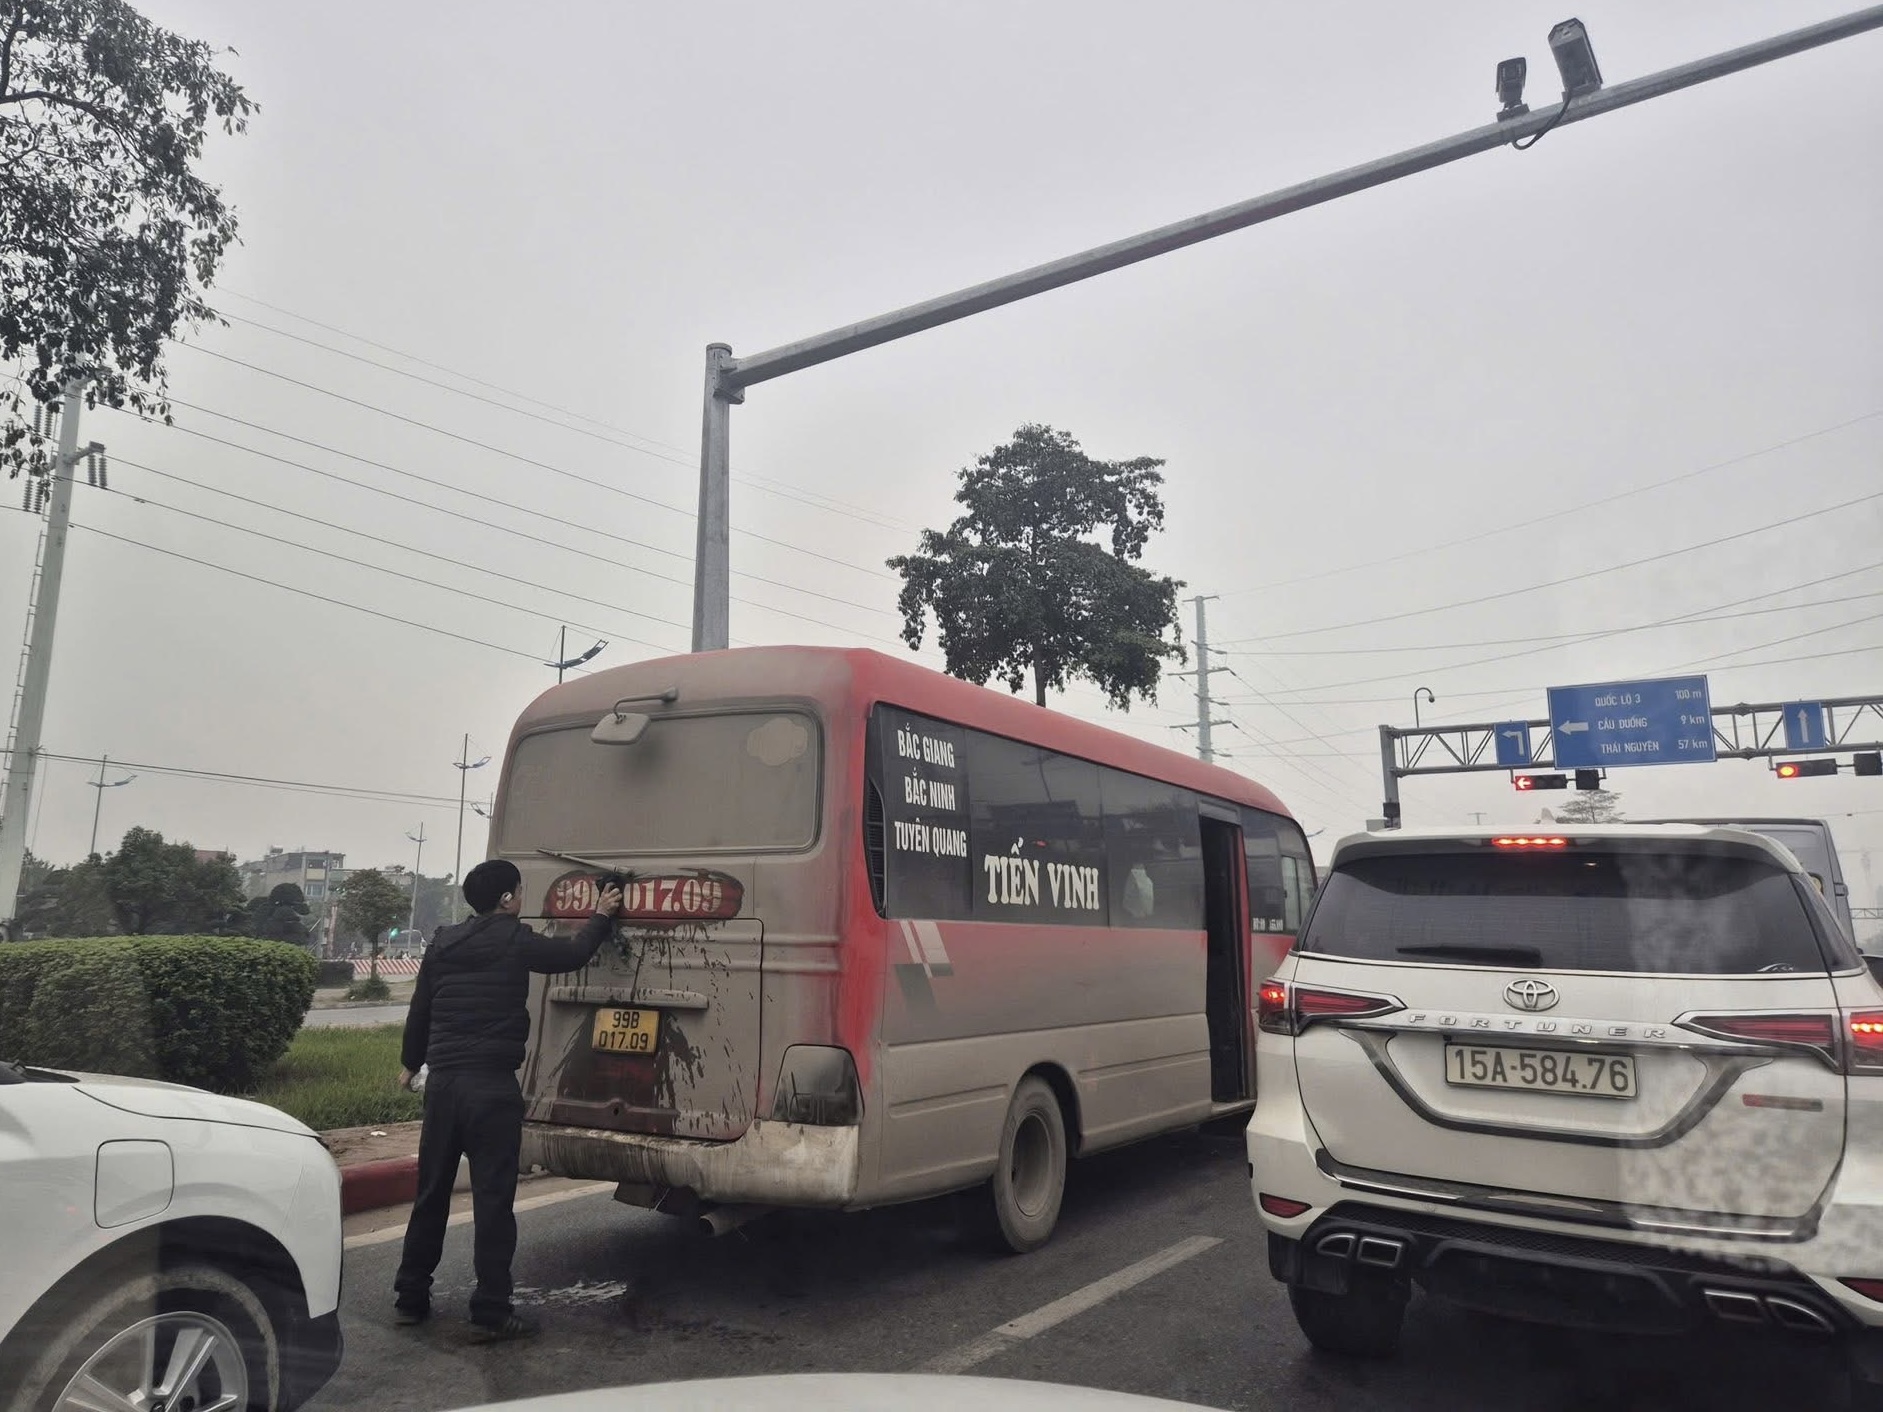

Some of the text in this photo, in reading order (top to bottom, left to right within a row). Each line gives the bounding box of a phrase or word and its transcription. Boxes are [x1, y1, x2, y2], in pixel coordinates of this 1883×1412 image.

[1635, 693, 1641, 704] 3
[1675, 689, 1690, 700] 100
[1692, 690, 1702, 699] m
[1680, 715, 1687, 725] 9
[1689, 715, 1705, 725] km
[897, 722, 955, 768] BẮC GIANG
[1601, 742, 1621, 754] THÁI
[1678, 739, 1689, 750] 57
[1692, 739, 1708, 749] km
[904, 766, 955, 811] BẮC NINH
[894, 817, 967, 858] TUYÊN QUANG
[984, 836, 1099, 911] TIẾN VINH
[612, 1011, 640, 1029] 99B
[1409, 1014, 1667, 1039] FORTUNER
[599, 1030, 649, 1050] 017.09
[1454, 1049, 1629, 1092] 15A-584.76
